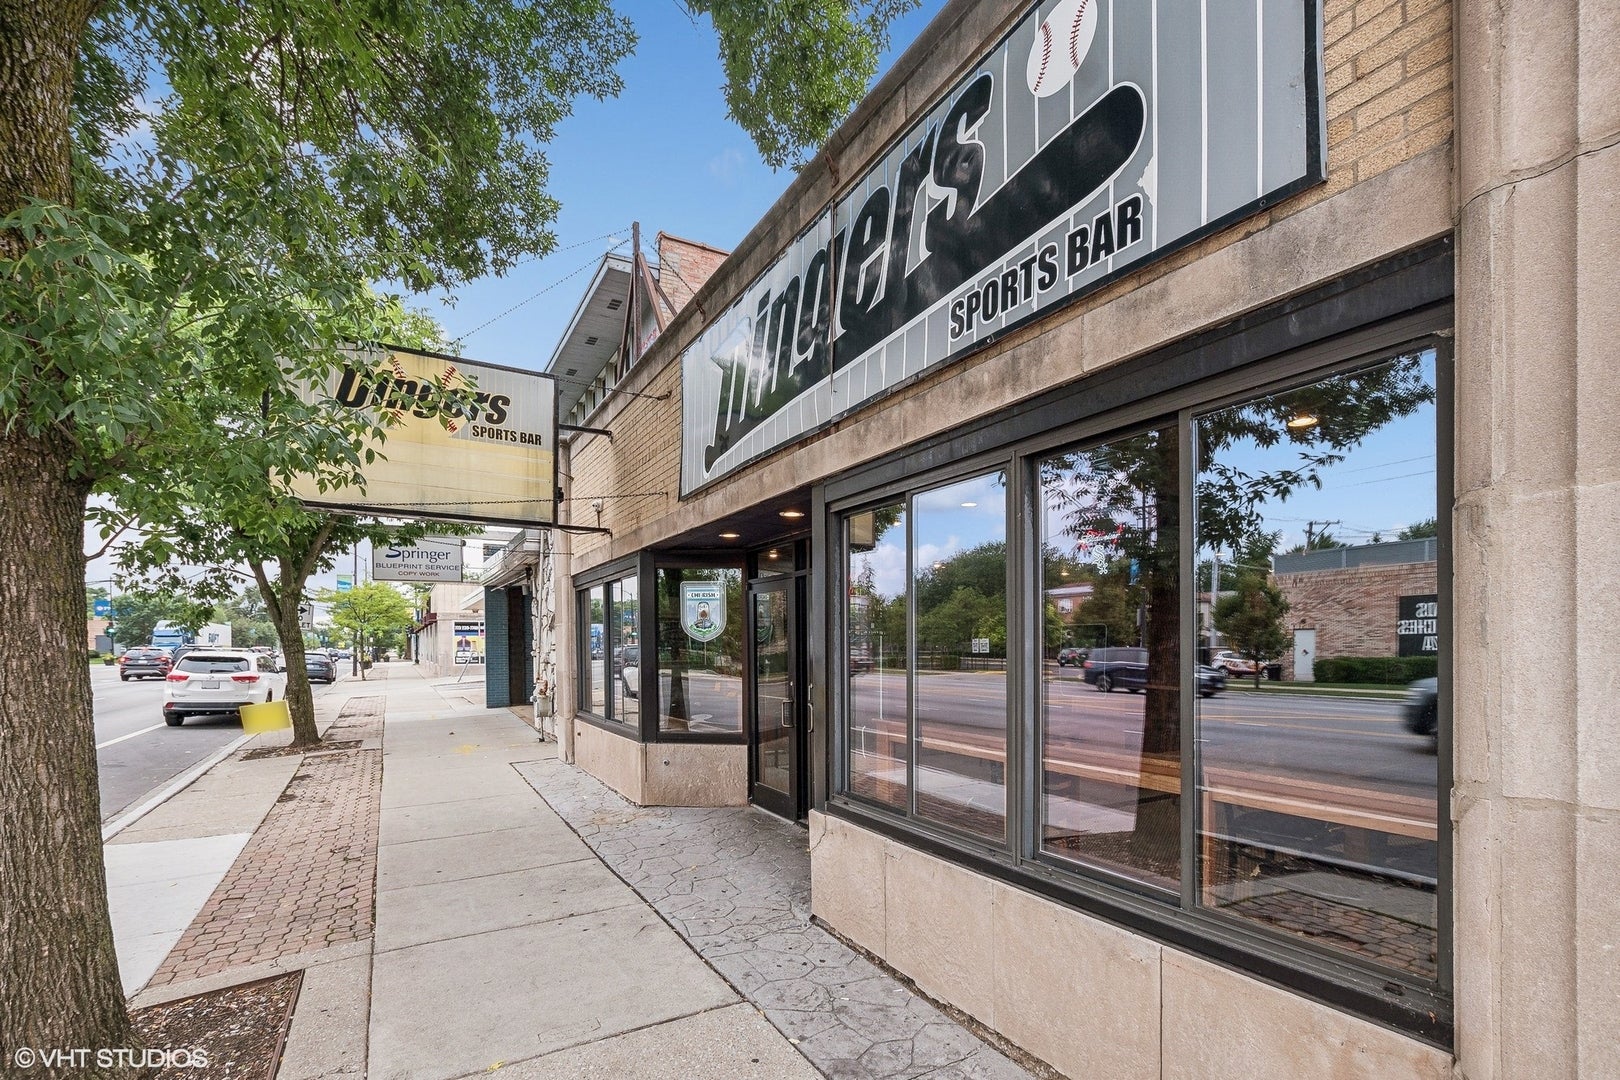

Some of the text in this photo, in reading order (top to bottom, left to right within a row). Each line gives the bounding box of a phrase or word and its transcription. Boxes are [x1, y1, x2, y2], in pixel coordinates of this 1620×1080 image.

[950, 193, 1143, 340] SPORTS BAR
[472, 425, 541, 446] SPORTS BAR
[385, 541, 451, 563] Springer
[375, 562, 422, 570] BLUEPRINT
